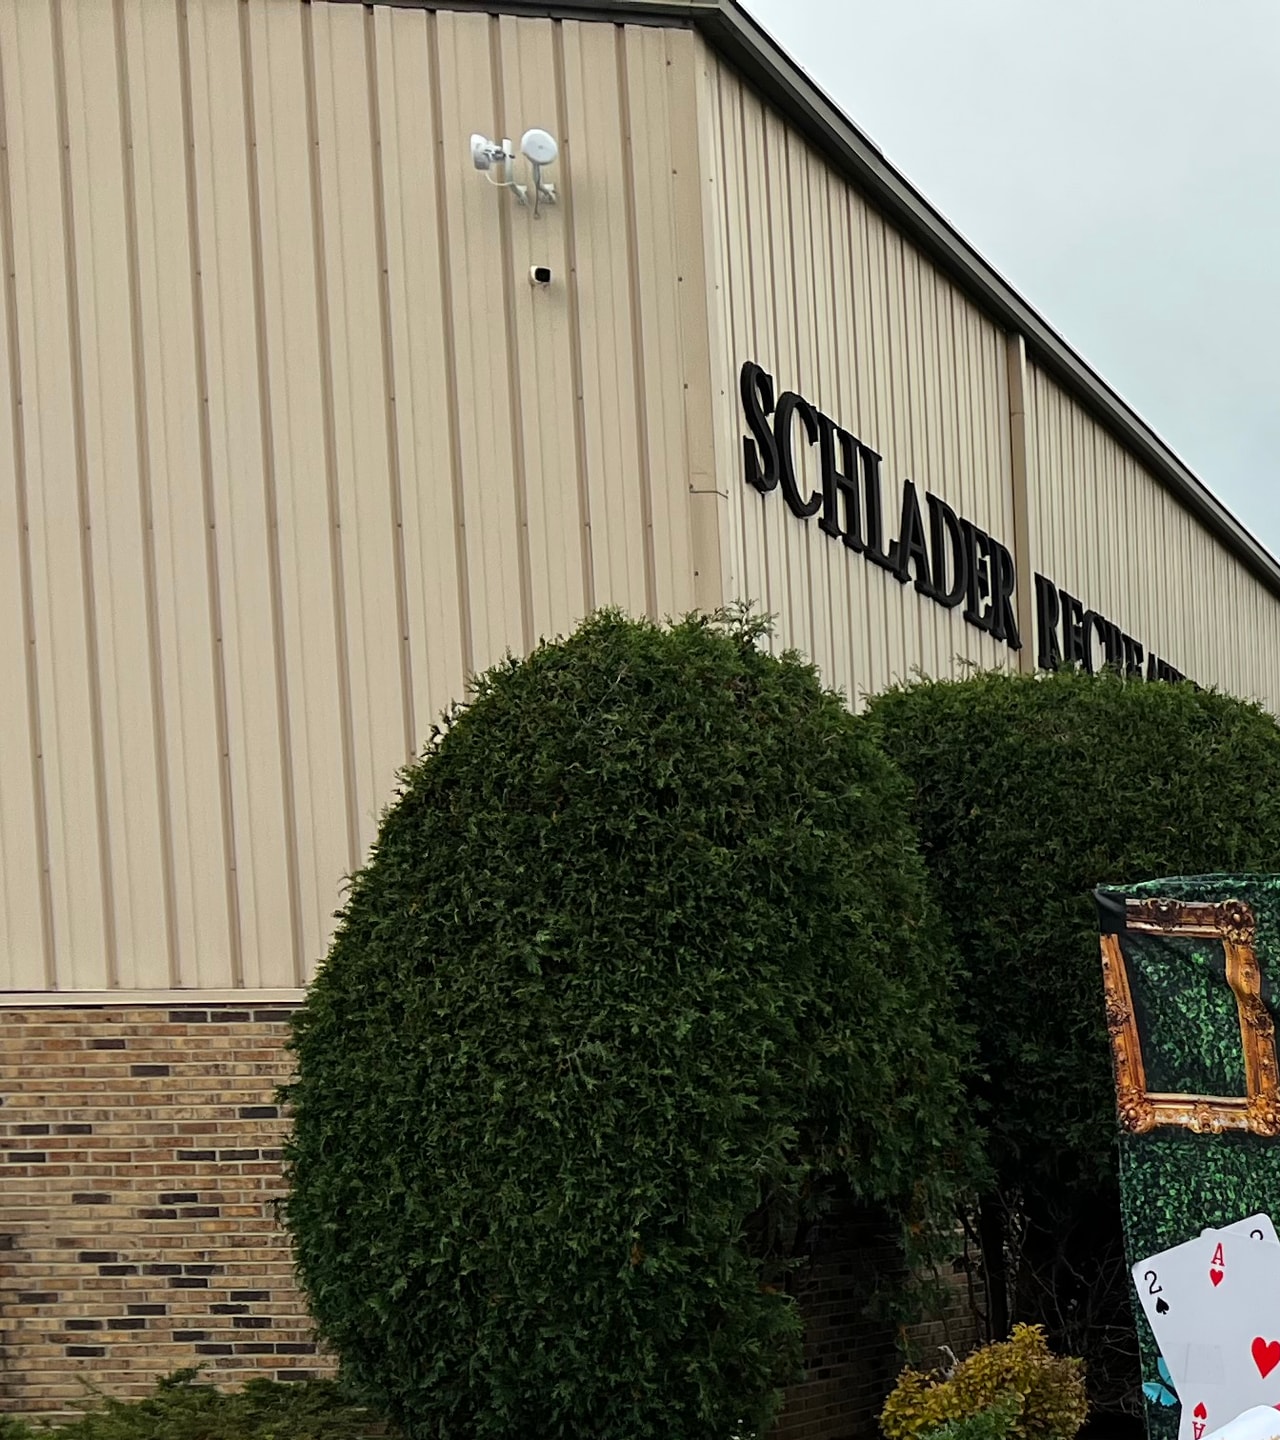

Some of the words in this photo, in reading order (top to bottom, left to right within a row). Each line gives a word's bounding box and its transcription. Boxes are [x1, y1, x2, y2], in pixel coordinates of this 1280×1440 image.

[740, 360, 1022, 650] SCHLADER
[1211, 1242, 1226, 1266] A
[1144, 1270, 1162, 1295] 2
